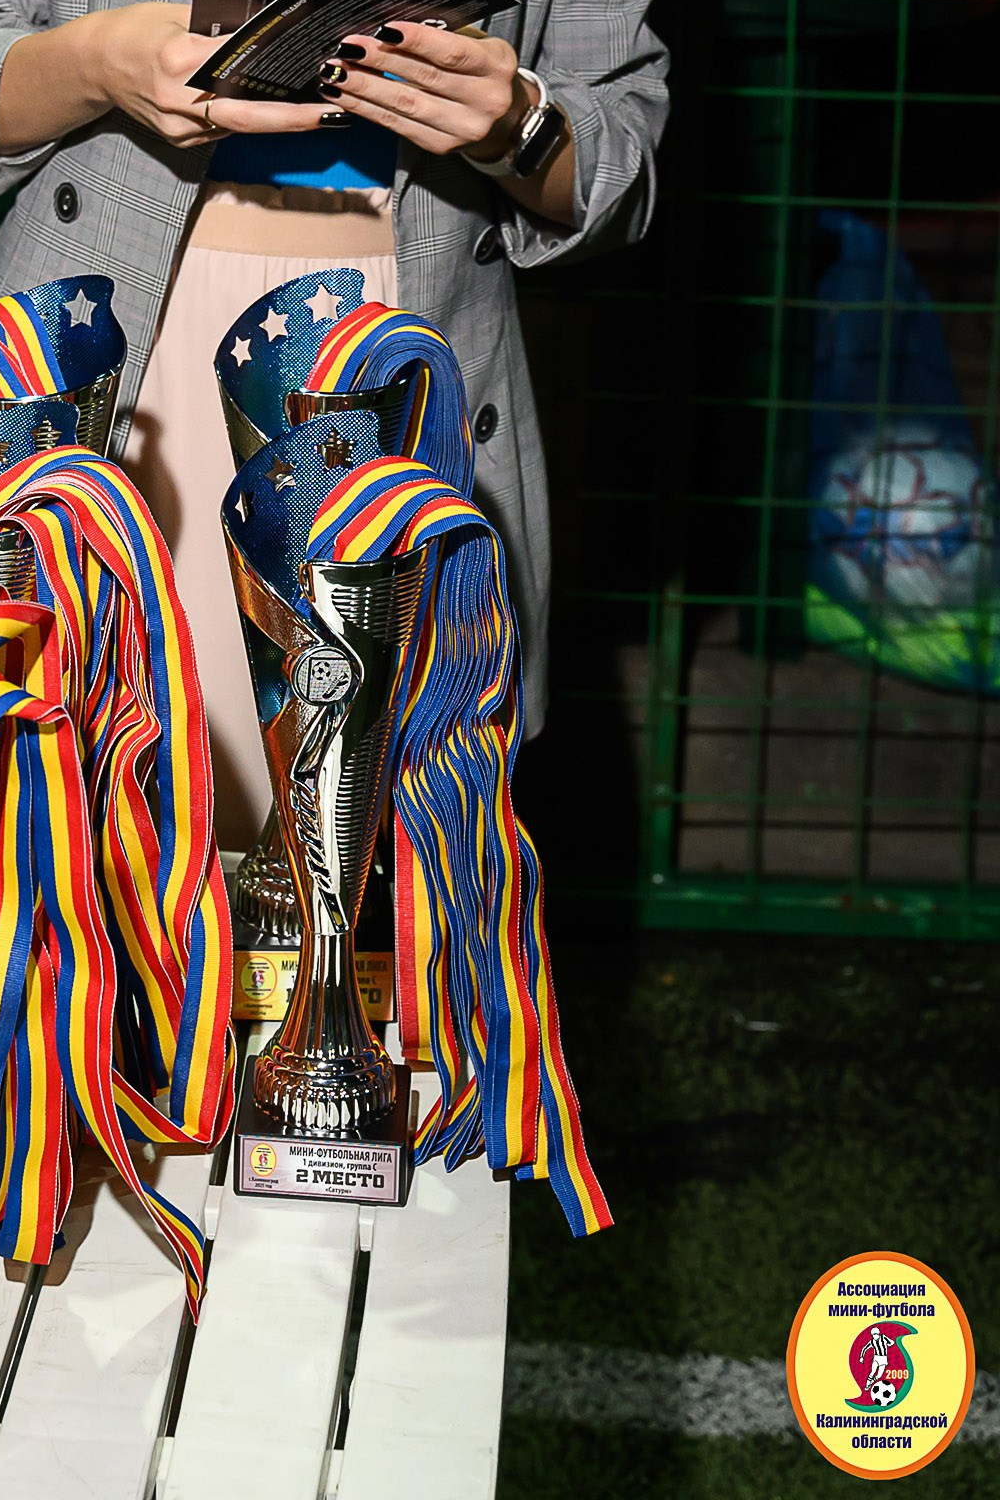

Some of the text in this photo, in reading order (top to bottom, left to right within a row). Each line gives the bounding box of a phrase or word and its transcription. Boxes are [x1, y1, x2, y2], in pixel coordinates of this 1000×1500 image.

[289, 1146, 393, 1163] МИНИ-ФУТБОЛЬНАЯ ЛИГА
[308, 1160, 346, 1170] дивизион,
[346, 1162, 372, 1171] группа
[296, 1169, 385, 1188] 2 МЕСТО
[325, 1186, 352, 1195] «Сатурн»
